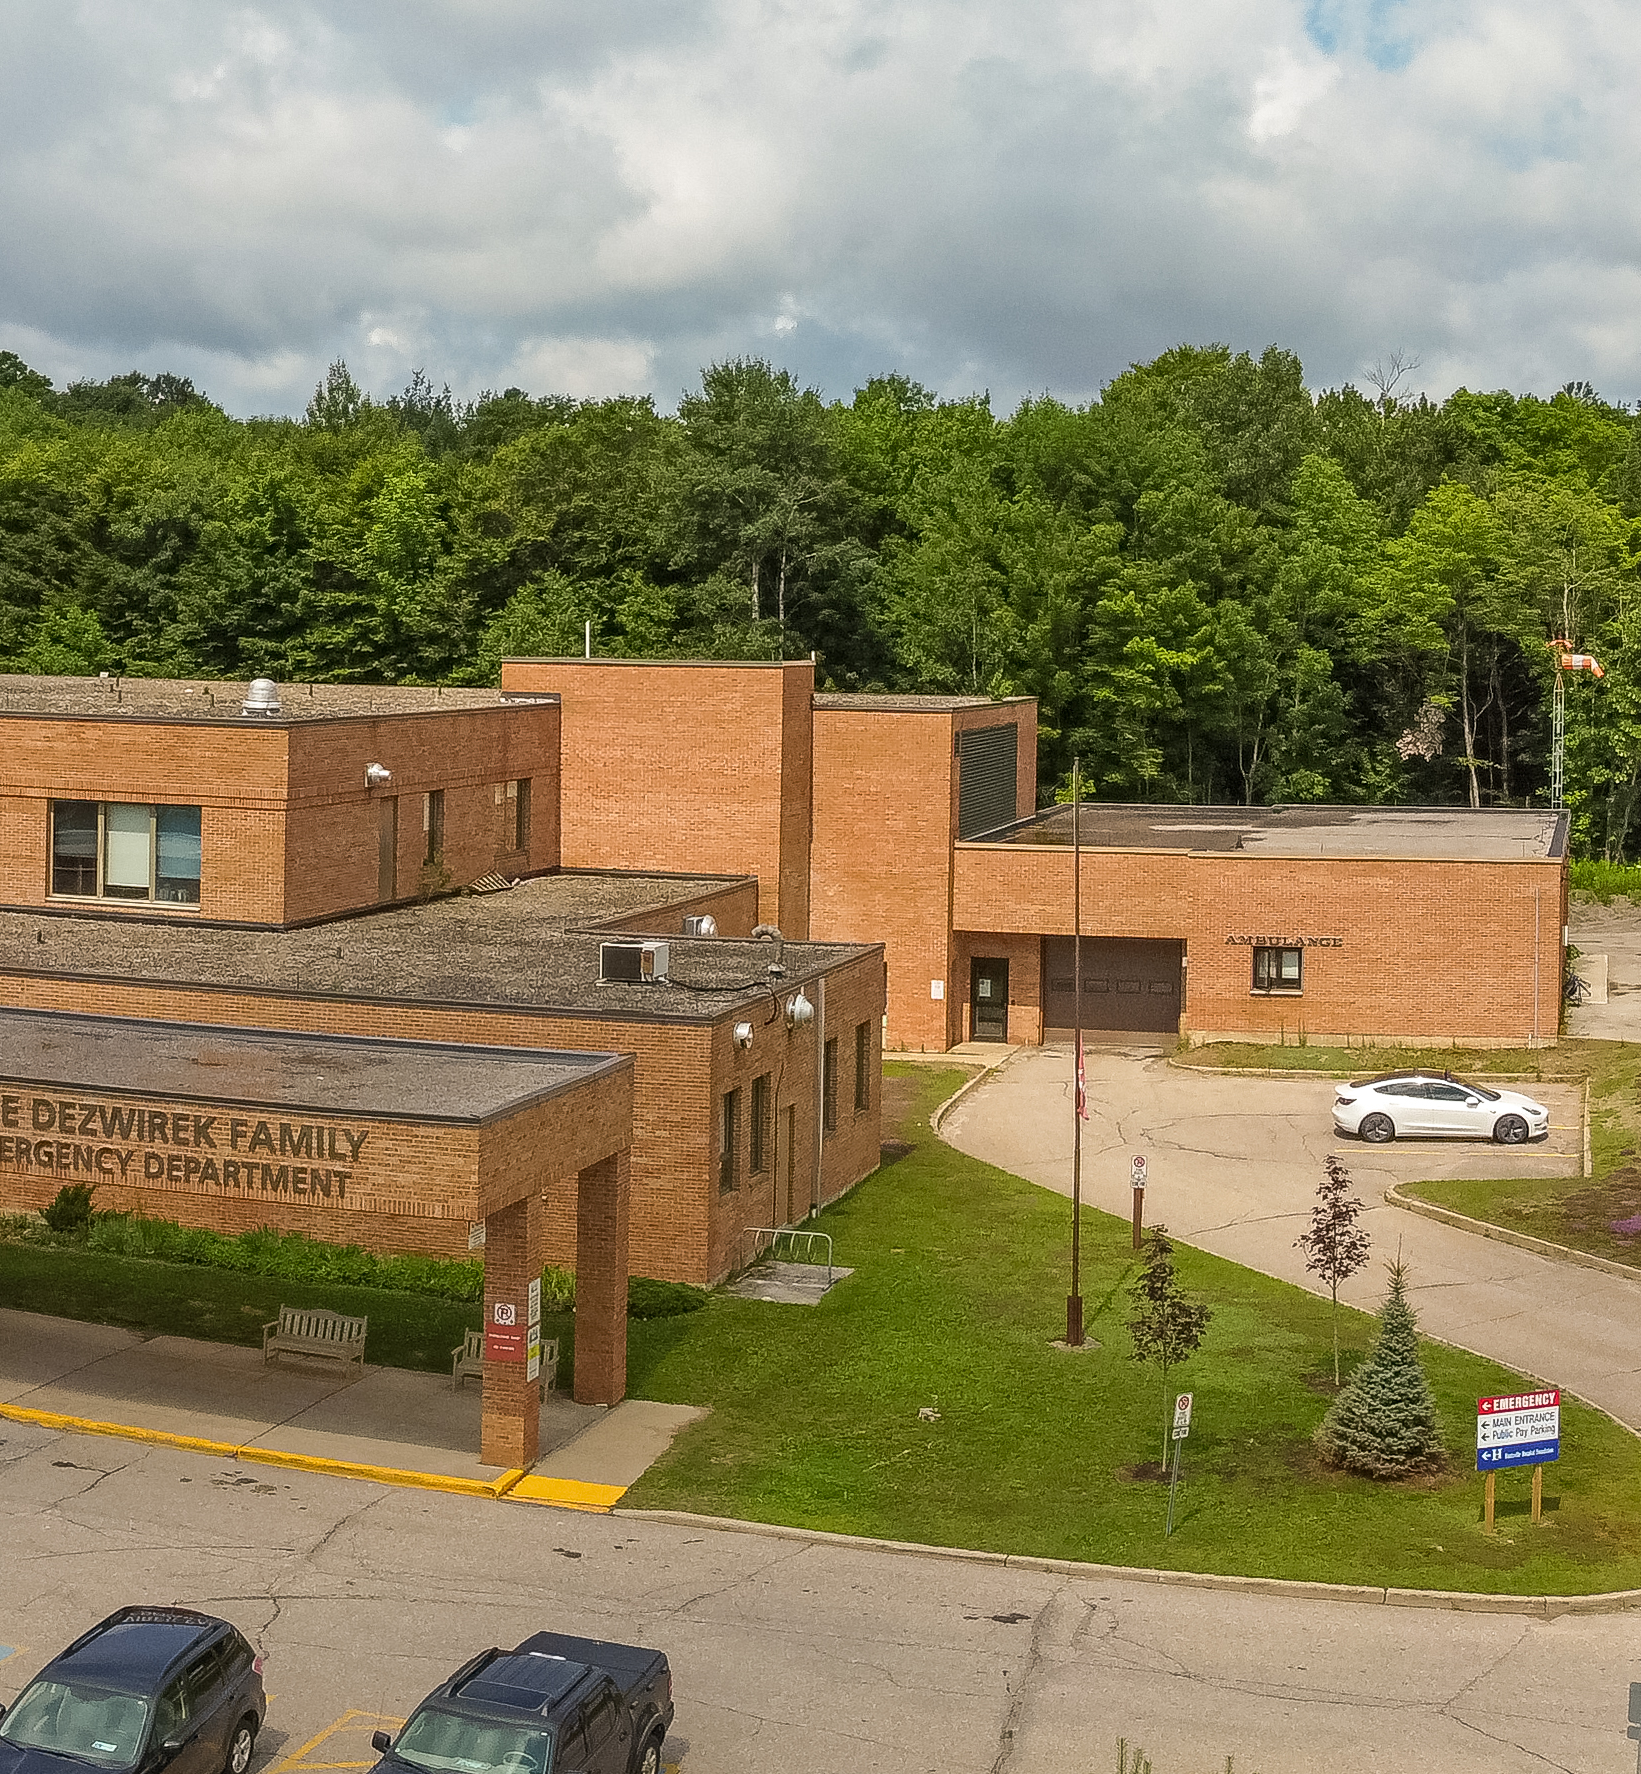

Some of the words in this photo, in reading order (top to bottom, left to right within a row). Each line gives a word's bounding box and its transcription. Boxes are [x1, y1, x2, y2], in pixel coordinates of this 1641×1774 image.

[1224, 935, 1343, 947] AMBULANCE
[32, 1098, 217, 1148] DEZWIREK
[230, 1118, 369, 1162] FAMILY
[144, 1151, 352, 1199] DEPARTMENT
[1493, 1392, 1556, 1411] EMERGENCY
[1493, 1417, 1512, 1428] MAIN
[1514, 1411, 1555, 1426] ENTRANCE
[1515, 1427, 1529, 1438] Pay
[1530, 1424, 1556, 1435] Parking
